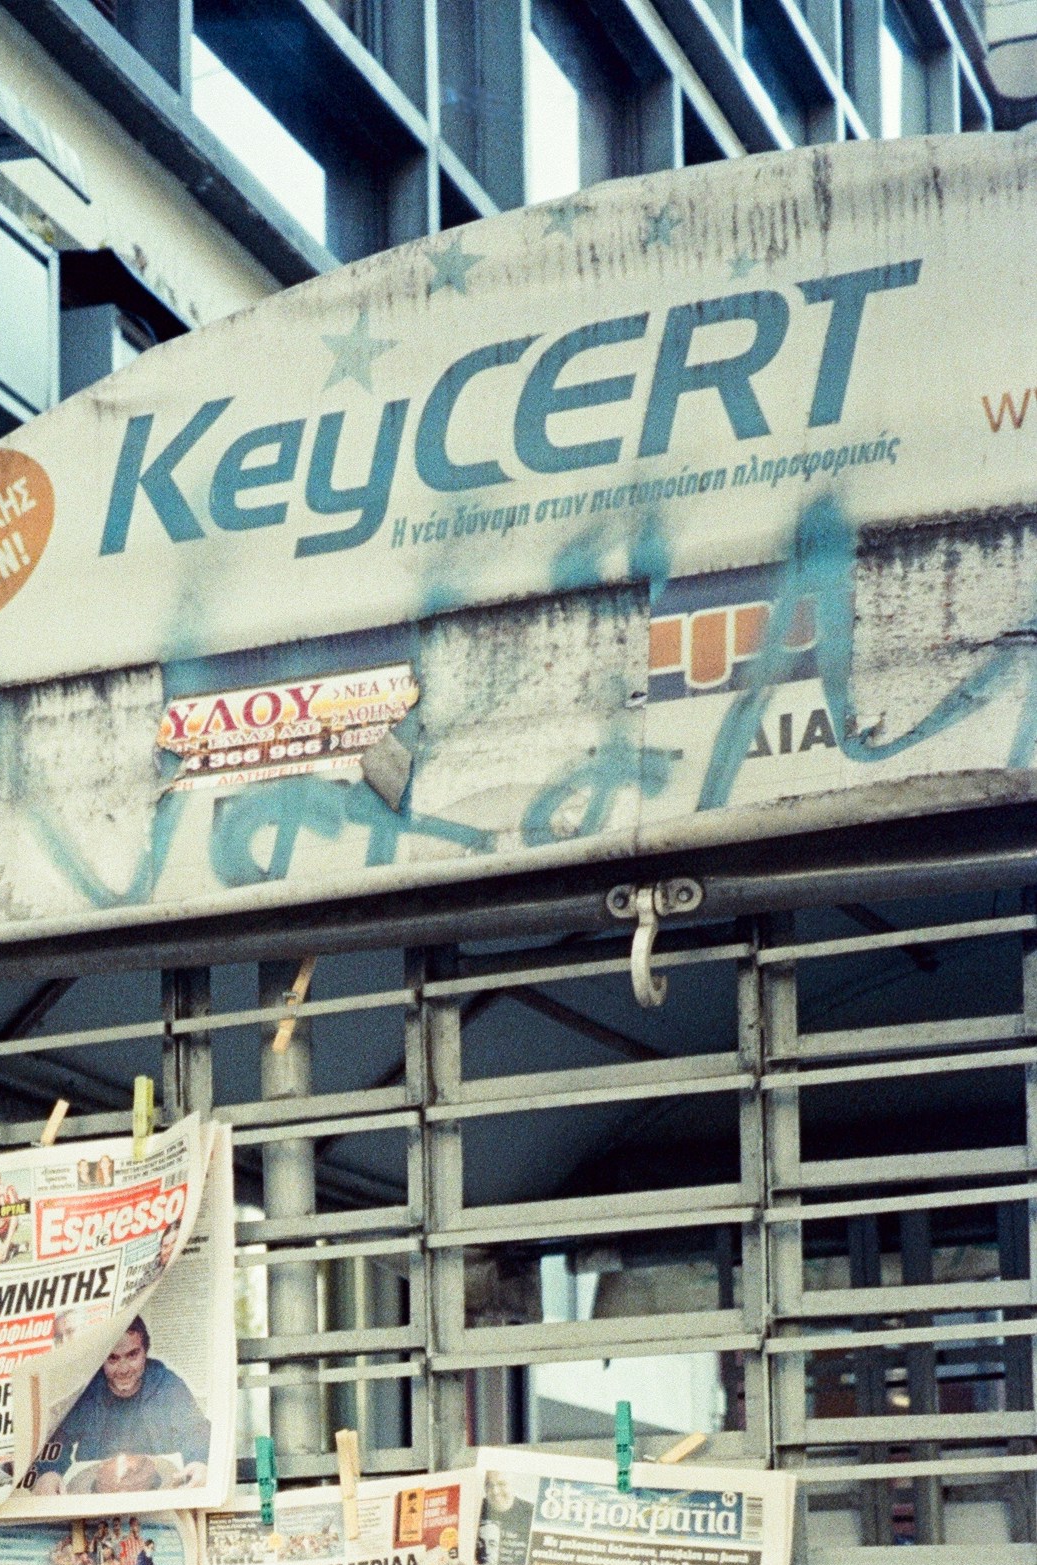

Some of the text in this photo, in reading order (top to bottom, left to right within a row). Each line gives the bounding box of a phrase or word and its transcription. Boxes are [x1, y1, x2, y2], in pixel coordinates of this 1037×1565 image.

[99, 258, 922, 559] KeyCERT
[391, 517, 408, 549] Η
[411, 510, 449, 545] νέα
[452, 500, 531, 538] δύναμη
[731, 429, 901, 489] πληροφορικής
[344, 680, 380, 701] ΝΕΑ
[208, 748, 262, 769] 366
[268, 740, 323, 760] 966
[39, 1189, 186, 1258] Espresso
